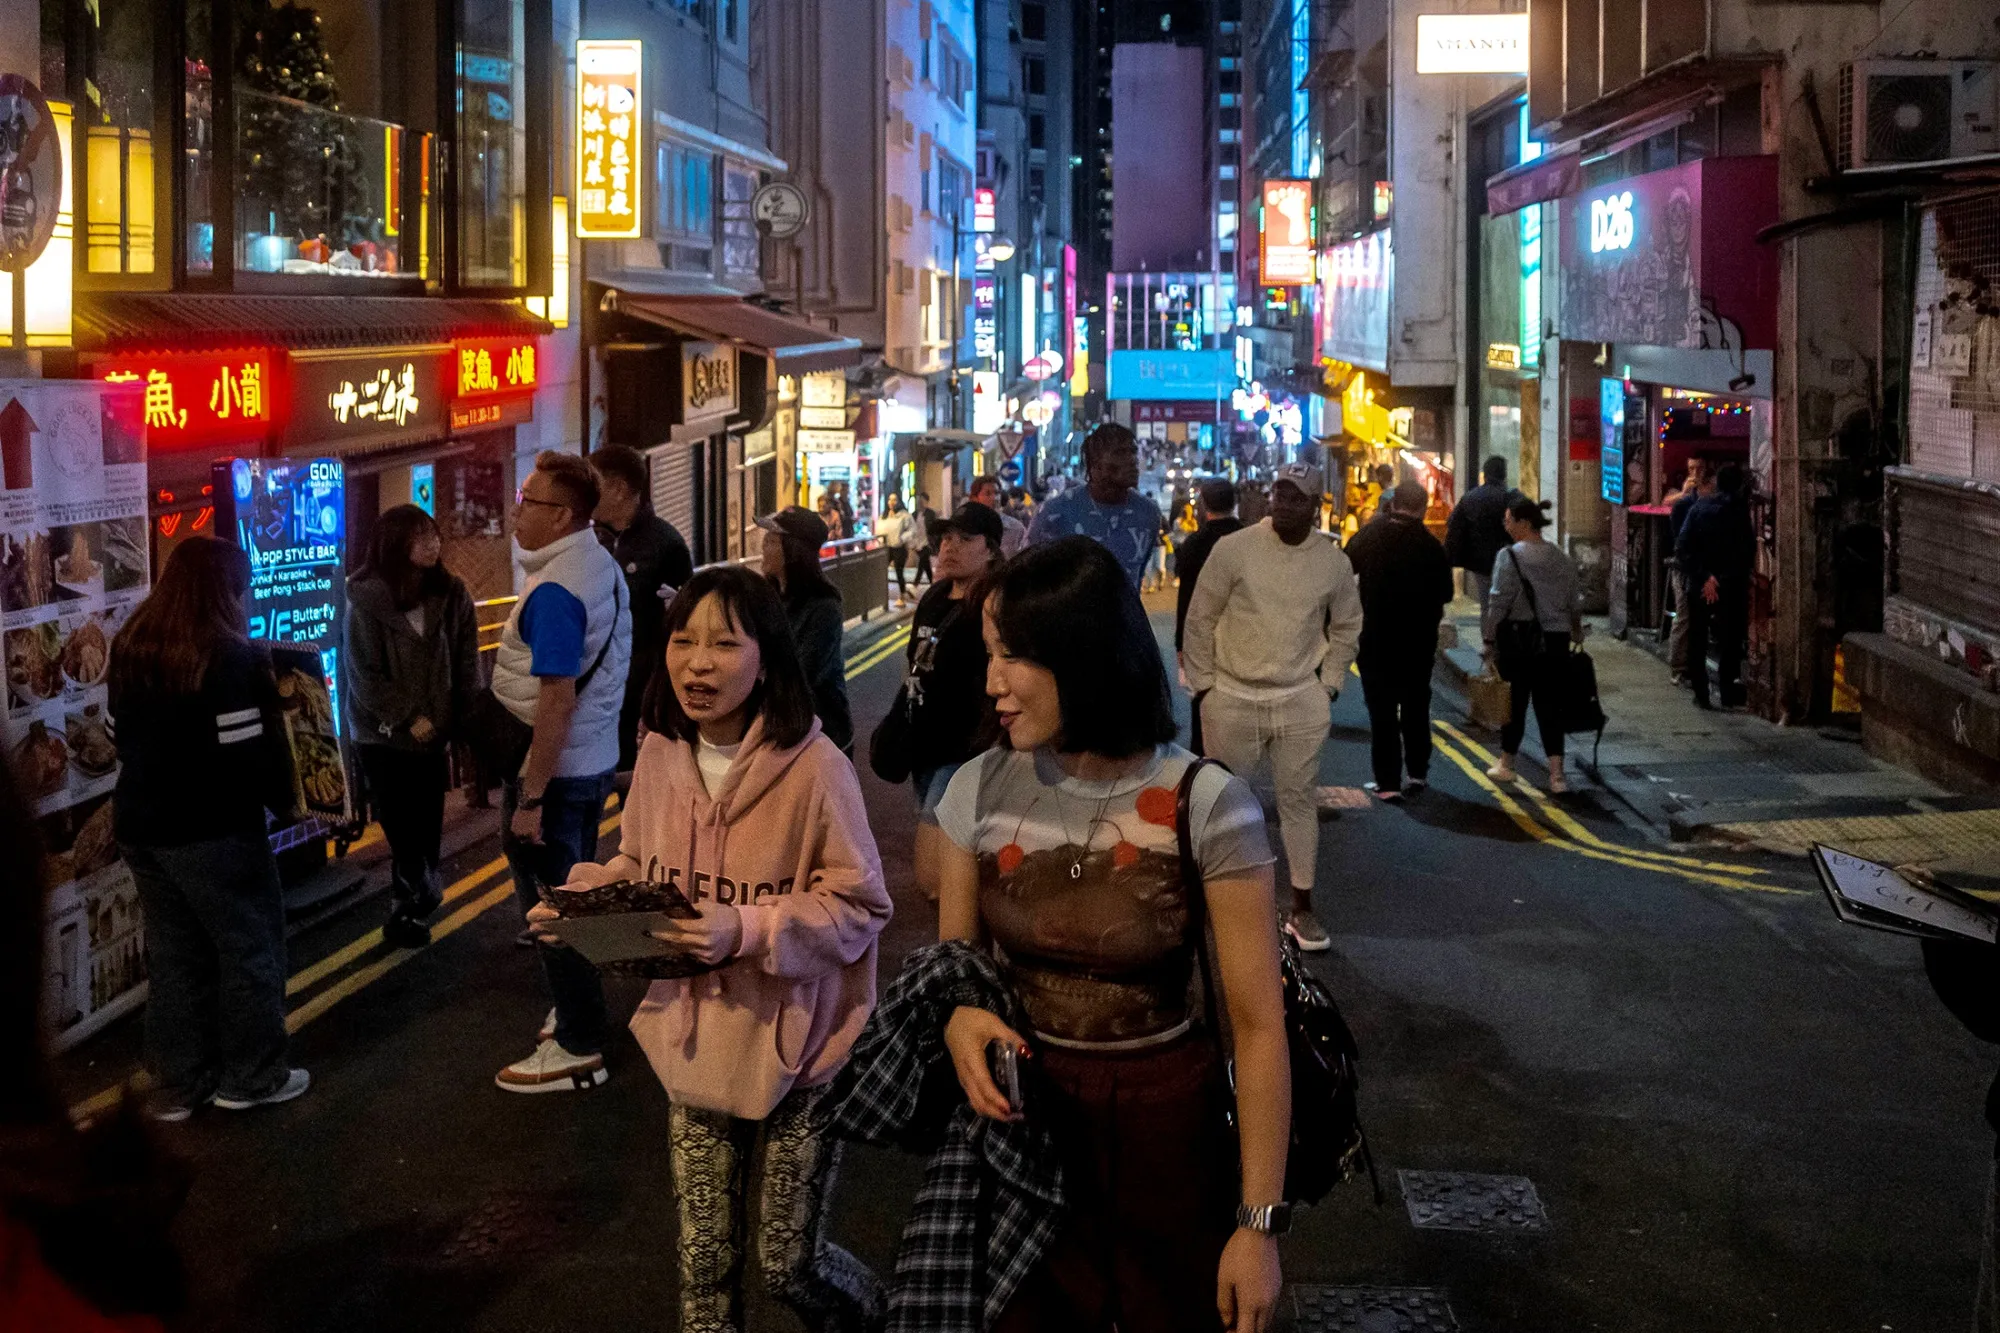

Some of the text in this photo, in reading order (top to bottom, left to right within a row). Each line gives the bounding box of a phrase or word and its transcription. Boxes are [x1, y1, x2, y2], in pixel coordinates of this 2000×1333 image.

[1591, 191, 1634, 254] D26
[310, 463, 342, 481] GON!
[285, 546, 314, 562] STYLE
[317, 545, 336, 559] BAR
[278, 569, 308, 582] Karaoke
[254, 586, 272, 600] Beer
[273, 583, 292, 597] Pong
[317, 578, 332, 591] Cup
[292, 629, 308, 643] on
